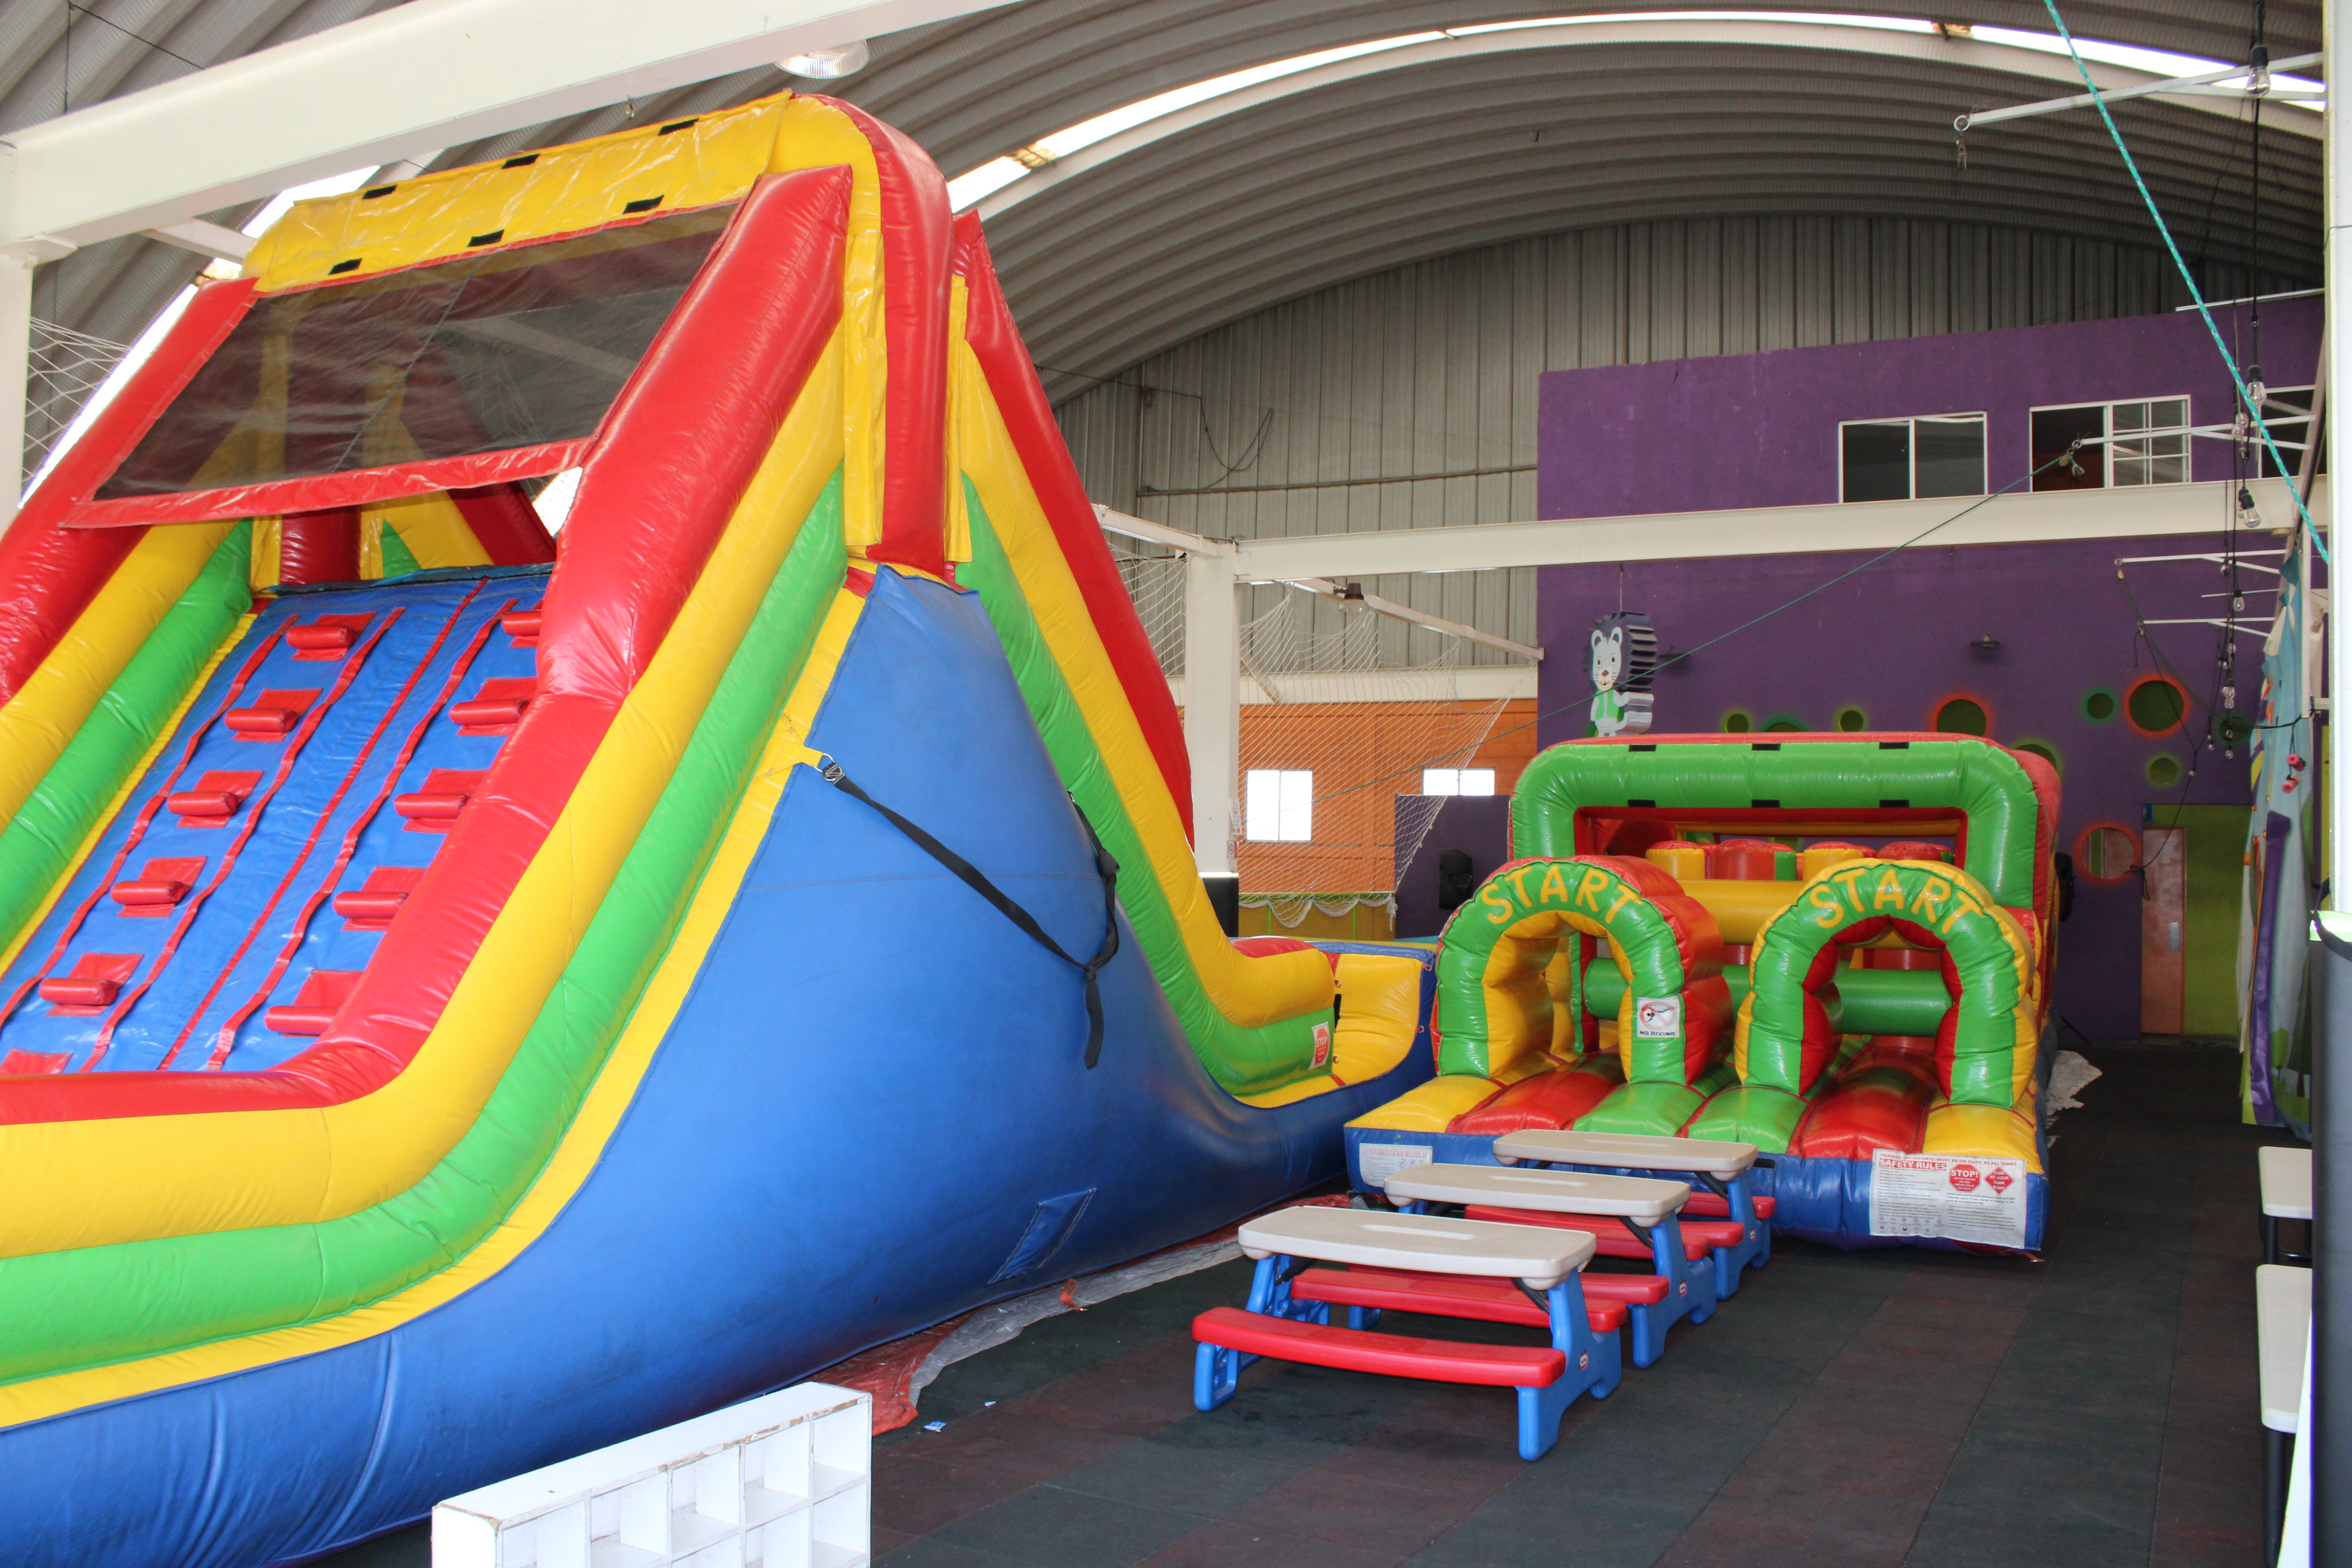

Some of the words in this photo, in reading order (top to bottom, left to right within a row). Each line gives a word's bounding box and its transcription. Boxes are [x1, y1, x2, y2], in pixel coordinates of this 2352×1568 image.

[1481, 864, 1643, 924] START
[1809, 869, 1984, 934] START
[1880, 1159, 1914, 1168] SAFETY
[1916, 1161, 1946, 1170] RULES
[1951, 1169, 1978, 1178] STOP!
